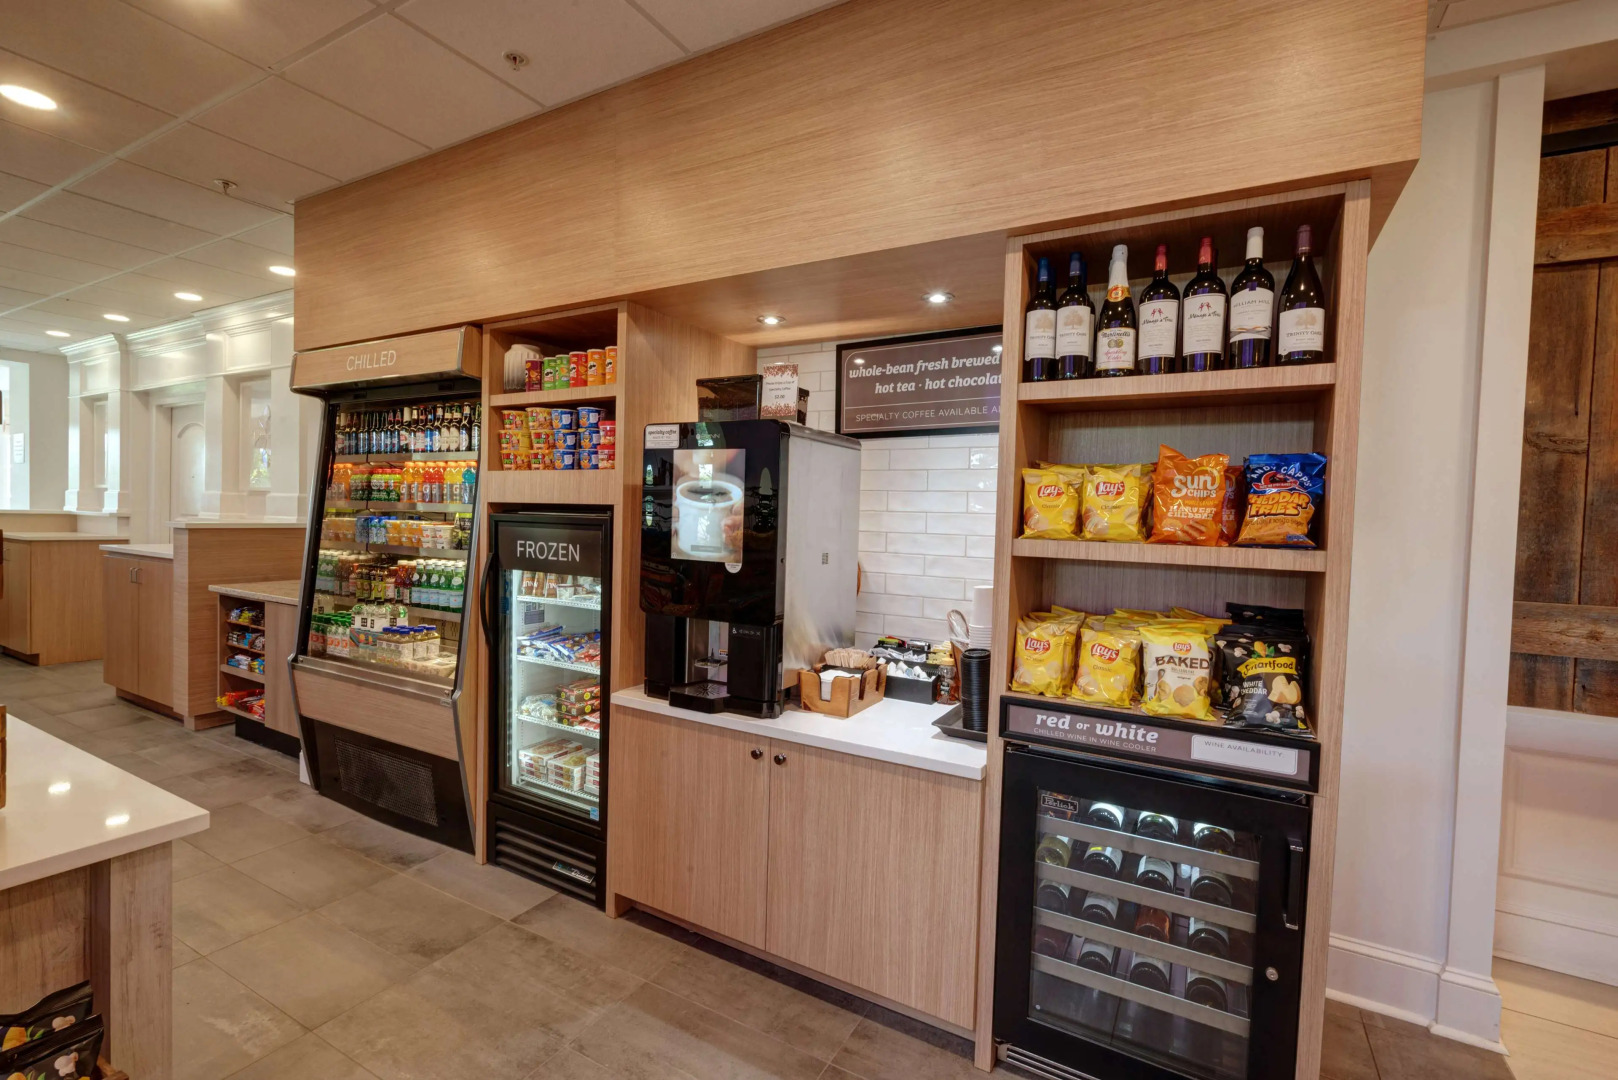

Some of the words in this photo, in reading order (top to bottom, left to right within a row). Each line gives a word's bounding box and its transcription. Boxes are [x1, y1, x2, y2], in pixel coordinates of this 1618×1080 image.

[346, 350, 397, 371] CHILLED
[849, 363, 914, 378] whole-bean
[914, 357, 949, 375] fresh
[951, 352, 1000, 369] brewed
[875, 382, 894, 394] hot
[896, 382, 916, 393] tea
[925, 377, 946, 390] hot
[855, 412, 900, 422] SPECIALTY
[902, 409, 936, 420] COFFEE
[938, 405, 988, 417] AVAILABLE
[1250, 465, 1276, 479] ANDY
[1039, 485, 1063, 497] Lay's
[1097, 481, 1124, 496] Lay's
[1170, 475, 1219, 498] Sun
[1187, 489, 1217, 498] CHIPS
[1250, 503, 1300, 516] FRIES
[517, 540, 580, 562] FROZEN
[1026, 637, 1049, 652] Lay's
[1092, 643, 1119, 659] Lay's
[1155, 655, 1209, 669] BAKED
[1243, 660, 1294, 676] Smartfood
[1243, 680, 1263, 688] WHITE
[1035, 714, 1071, 730] red
[1076, 722, 1090, 730] or
[1095, 722, 1159, 743] white
[1033, 727, 1065, 738] CHILLED
[1067, 732, 1087, 742] WINE
[1099, 738, 1120, 747] WINE
[1123, 742, 1157, 753] COOLER
[1204, 741, 1225, 749] WINE
